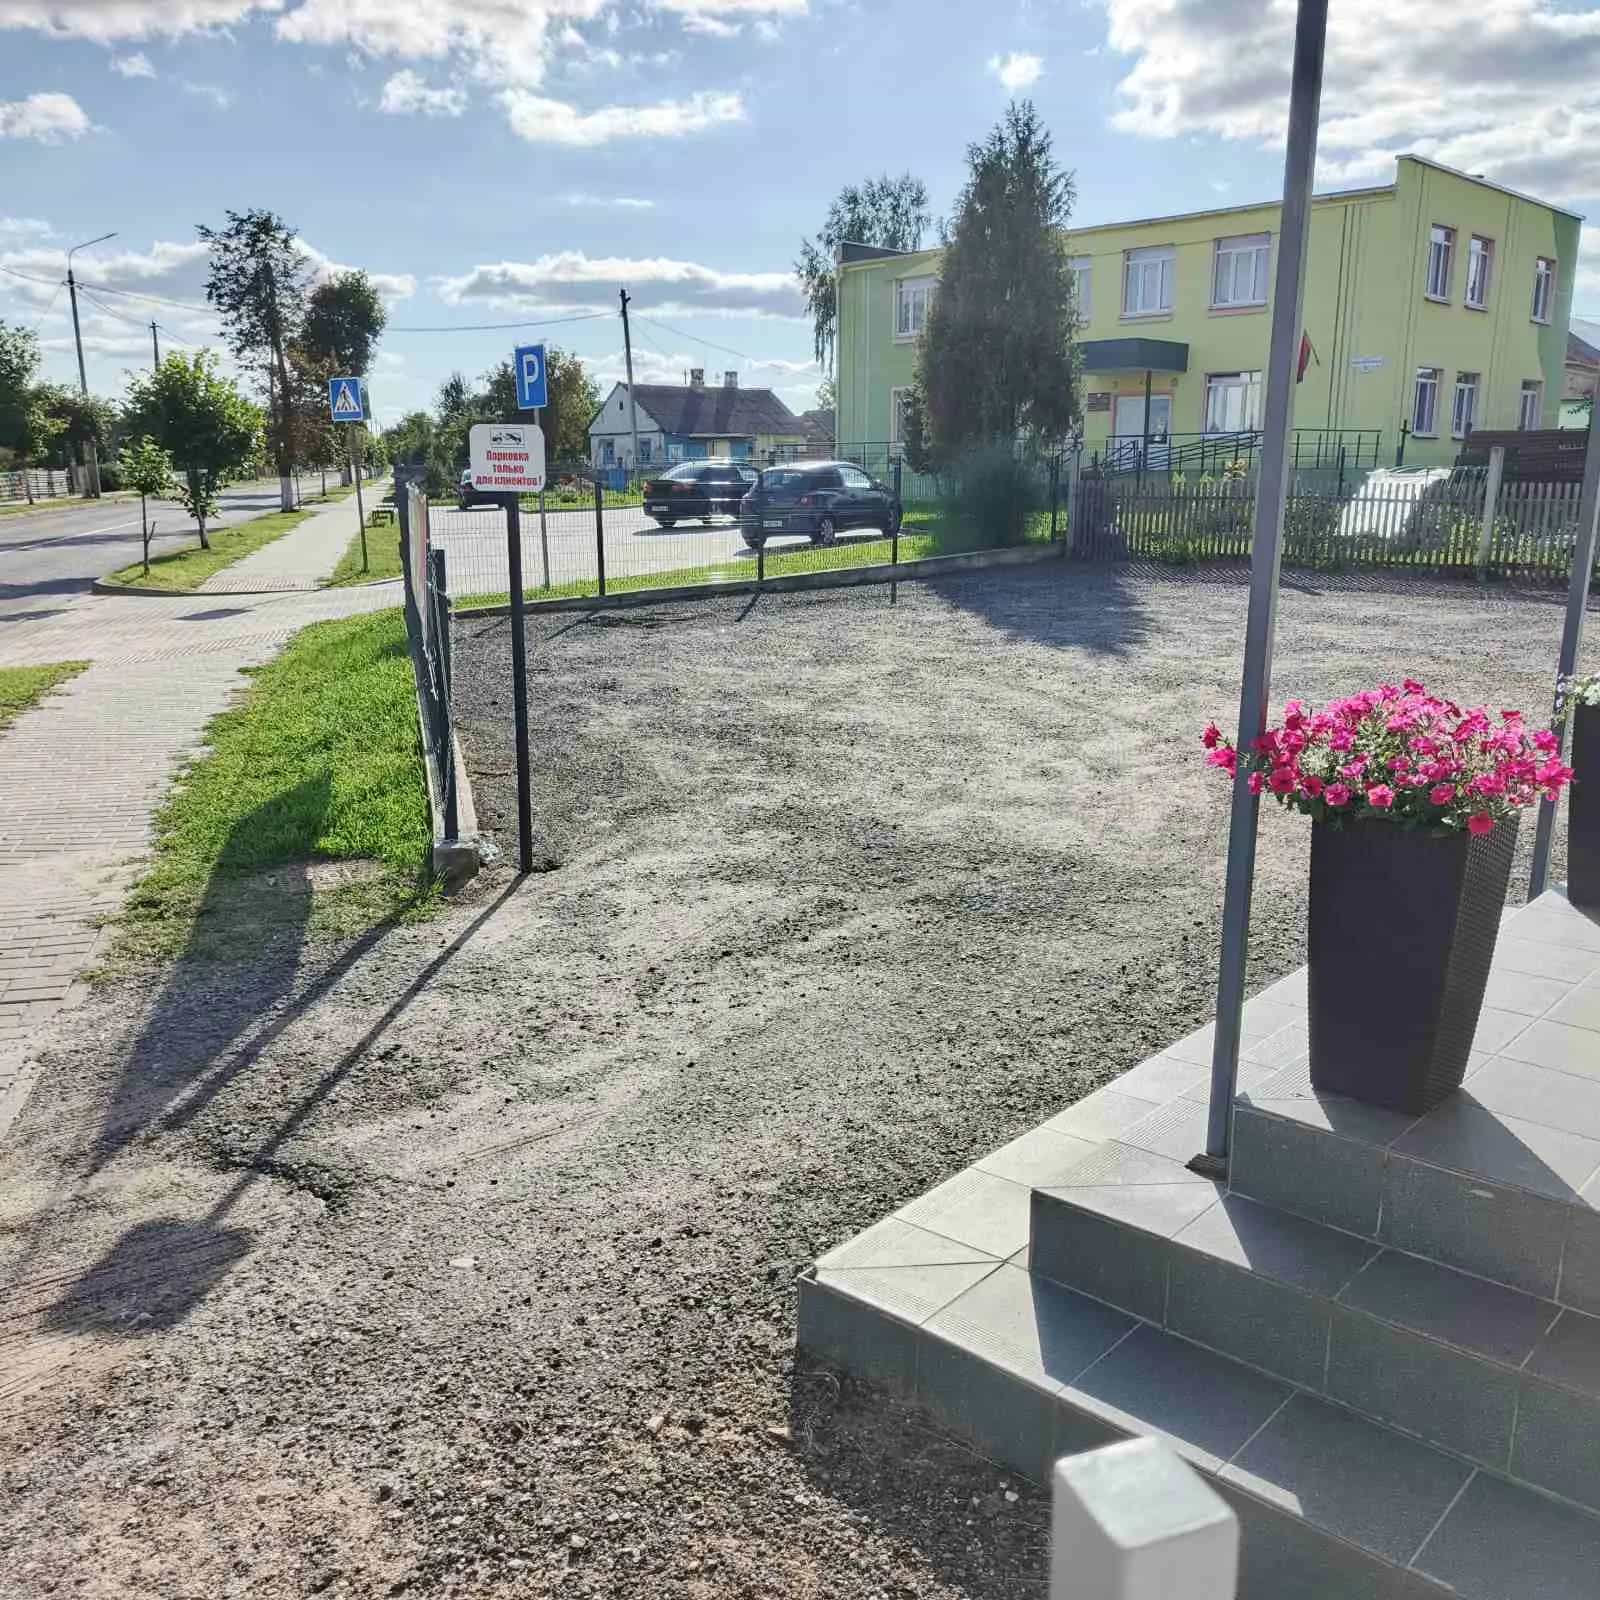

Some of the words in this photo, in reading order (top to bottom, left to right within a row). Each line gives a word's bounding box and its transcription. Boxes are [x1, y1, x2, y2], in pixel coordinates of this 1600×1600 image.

[522, 353, 539, 401] P
[486, 450, 529, 461] Парковка
[493, 464, 525, 473] только
[475, 475, 493, 485] для
